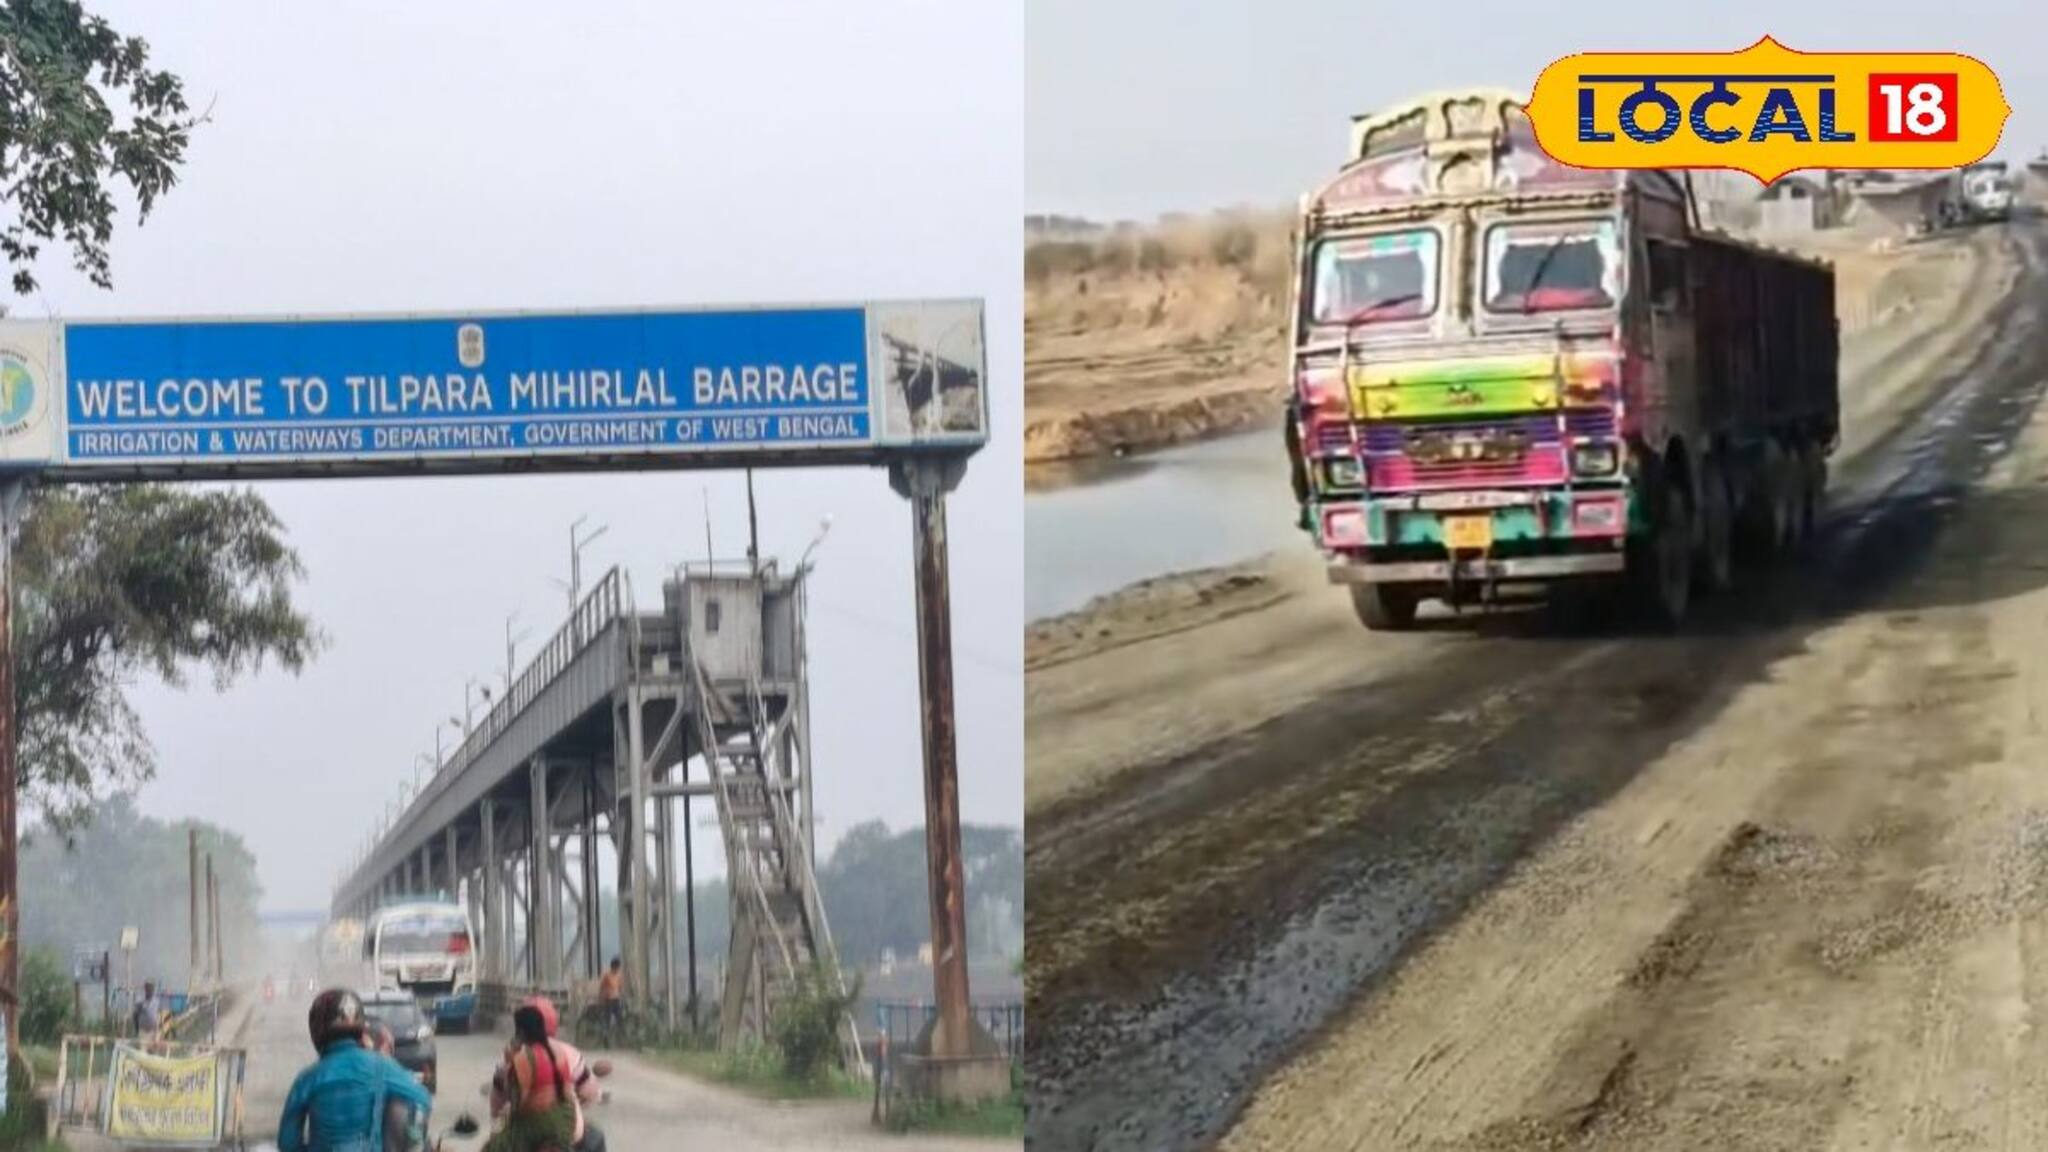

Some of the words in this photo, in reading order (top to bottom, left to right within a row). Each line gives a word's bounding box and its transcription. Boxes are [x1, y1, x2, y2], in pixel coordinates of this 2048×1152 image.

[77, 378, 265, 418] WELCOME
[281, 376, 328, 415] TO
[346, 373, 493, 413] TILPARA
[511, 367, 677, 410] MIHIRLAL
[693, 363, 859, 405] BARRAGE
[78, 430, 199, 455] IRRIGATION
[209, 431, 223, 451] &
[233, 428, 363, 452] WATERWAYS
[373, 424, 515, 450] DEPARTMENT,
[524, 418, 667, 445] GOVERNMENT
[676, 417, 701, 439] OF
[711, 416, 769, 439] WEST
[778, 414, 859, 438] BENGAL
